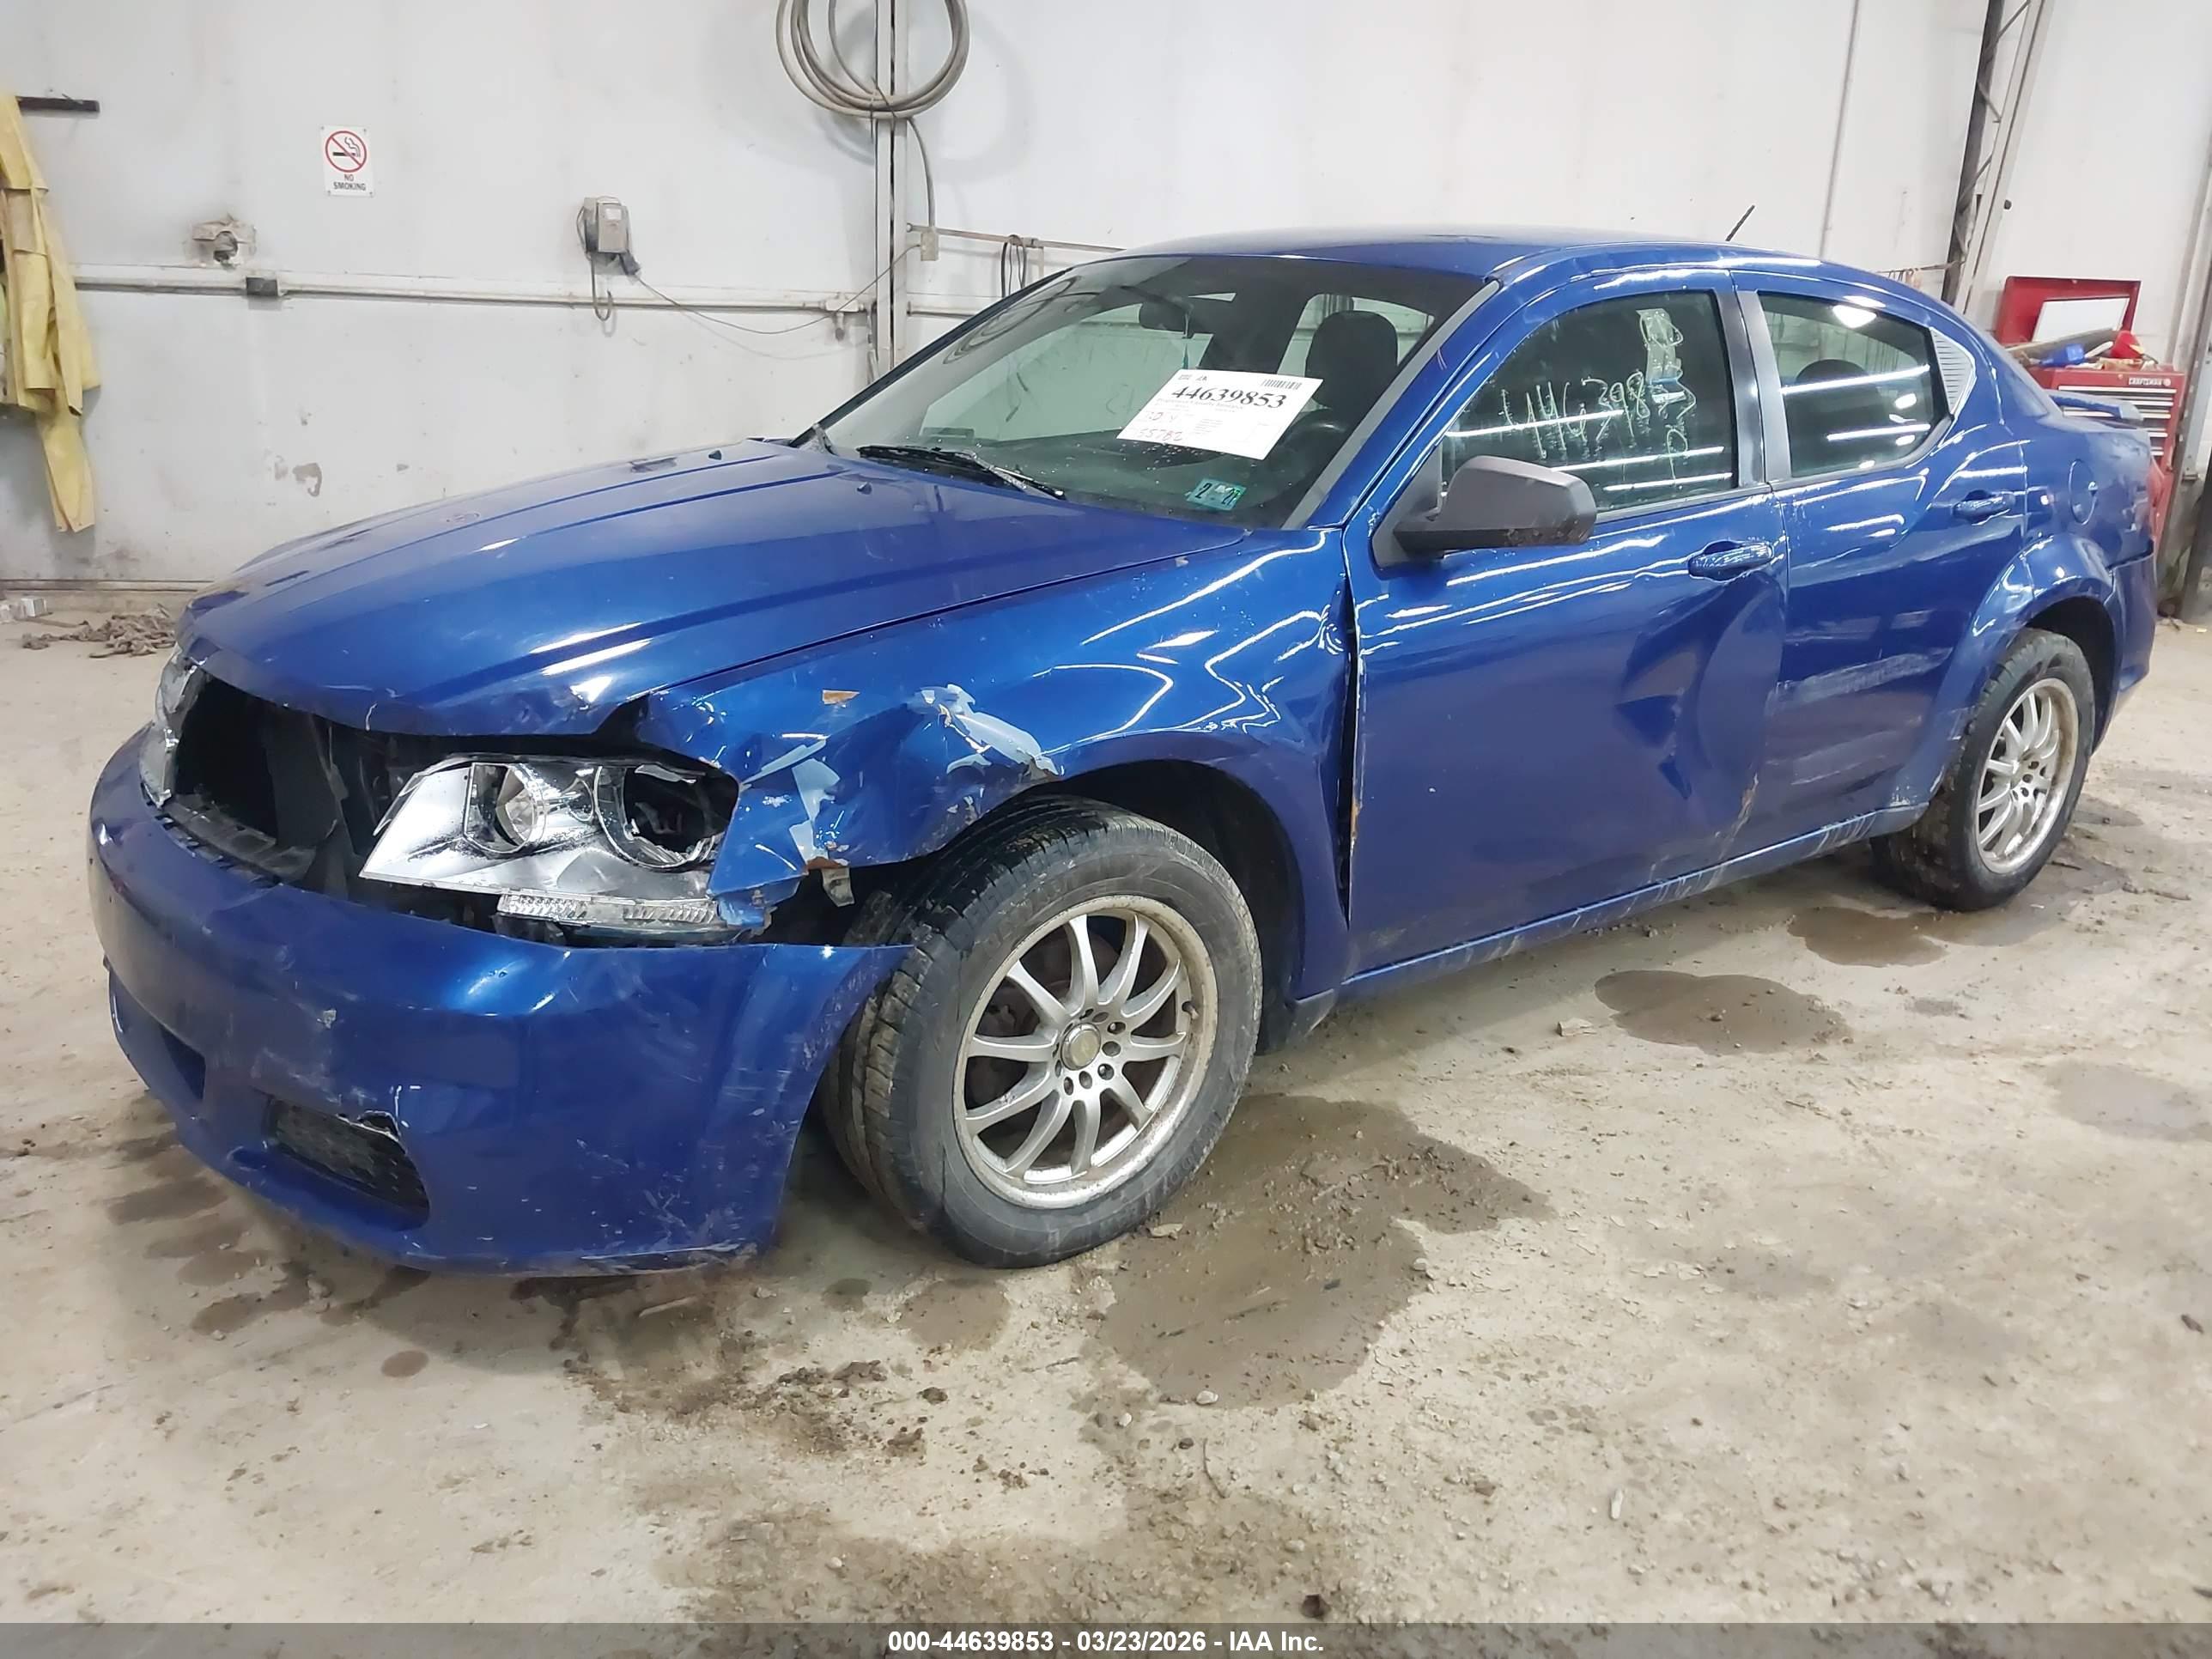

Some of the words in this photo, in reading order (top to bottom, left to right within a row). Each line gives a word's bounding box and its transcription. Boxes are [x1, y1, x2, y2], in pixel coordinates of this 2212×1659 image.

[333, 182, 366, 191] SMOKING
[1171, 386, 1286, 408] 44639853
[1194, 483, 1212, 499] 2
